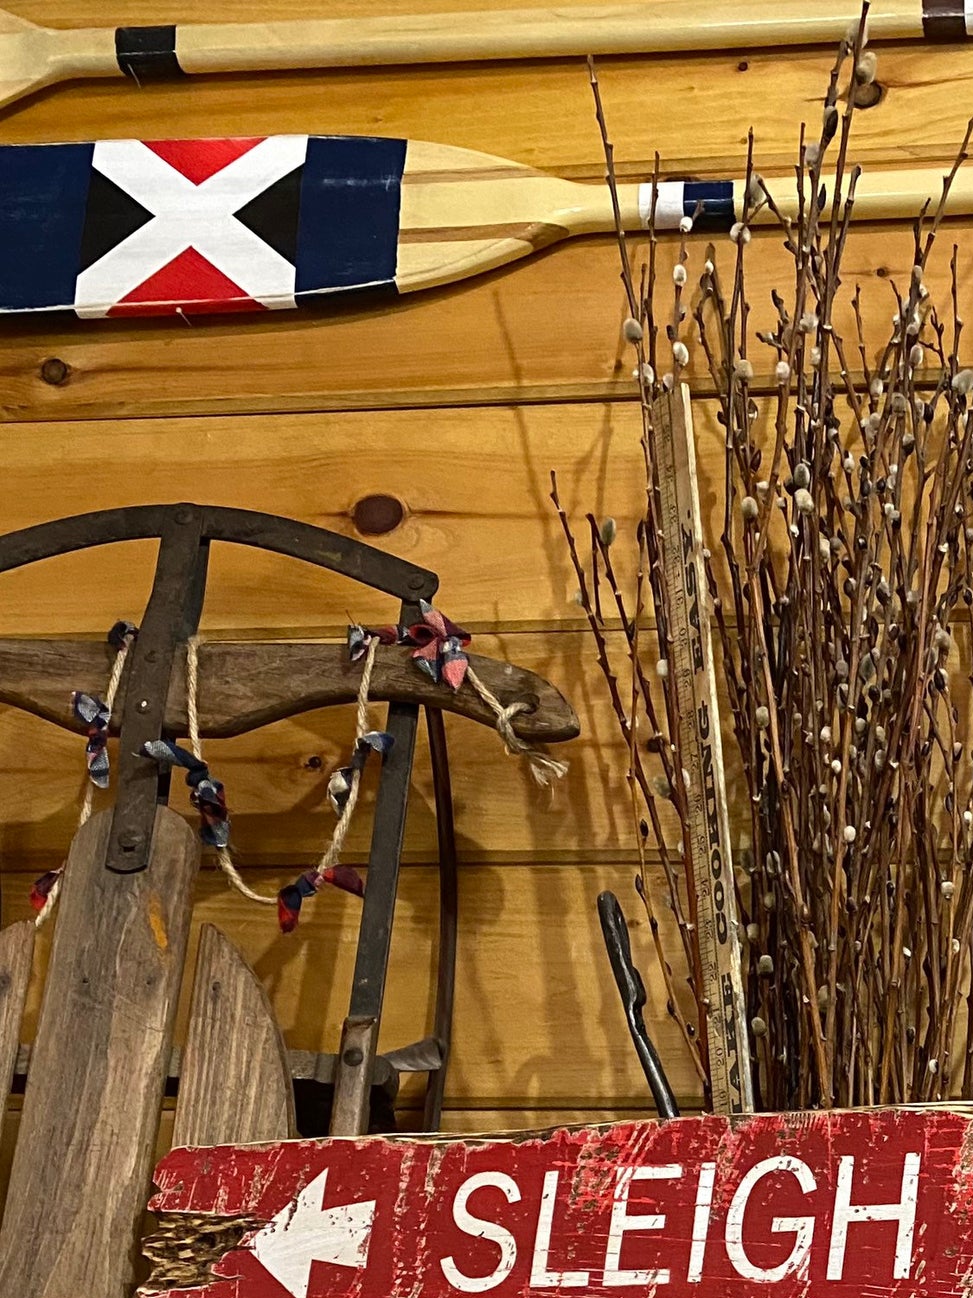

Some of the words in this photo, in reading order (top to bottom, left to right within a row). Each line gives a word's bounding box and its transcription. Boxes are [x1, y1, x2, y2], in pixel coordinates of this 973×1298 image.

[672, 544, 681, 565] 32
[676, 588, 685, 605] 31
[681, 509, 705, 675] EASY.
[679, 627, 688, 647] 30
[682, 668, 691, 688] 29
[687, 709, 696, 729] 28
[690, 753, 699, 770] 27
[694, 793, 703, 813] 26
[698, 700, 728, 945] COOKING
[699, 835, 707, 856] 25
[705, 920, 713, 940] 23
[708, 962, 717, 982] 22
[716, 1047, 725, 1067] 20
[439, 1152, 920, 1293] SLEIGH
